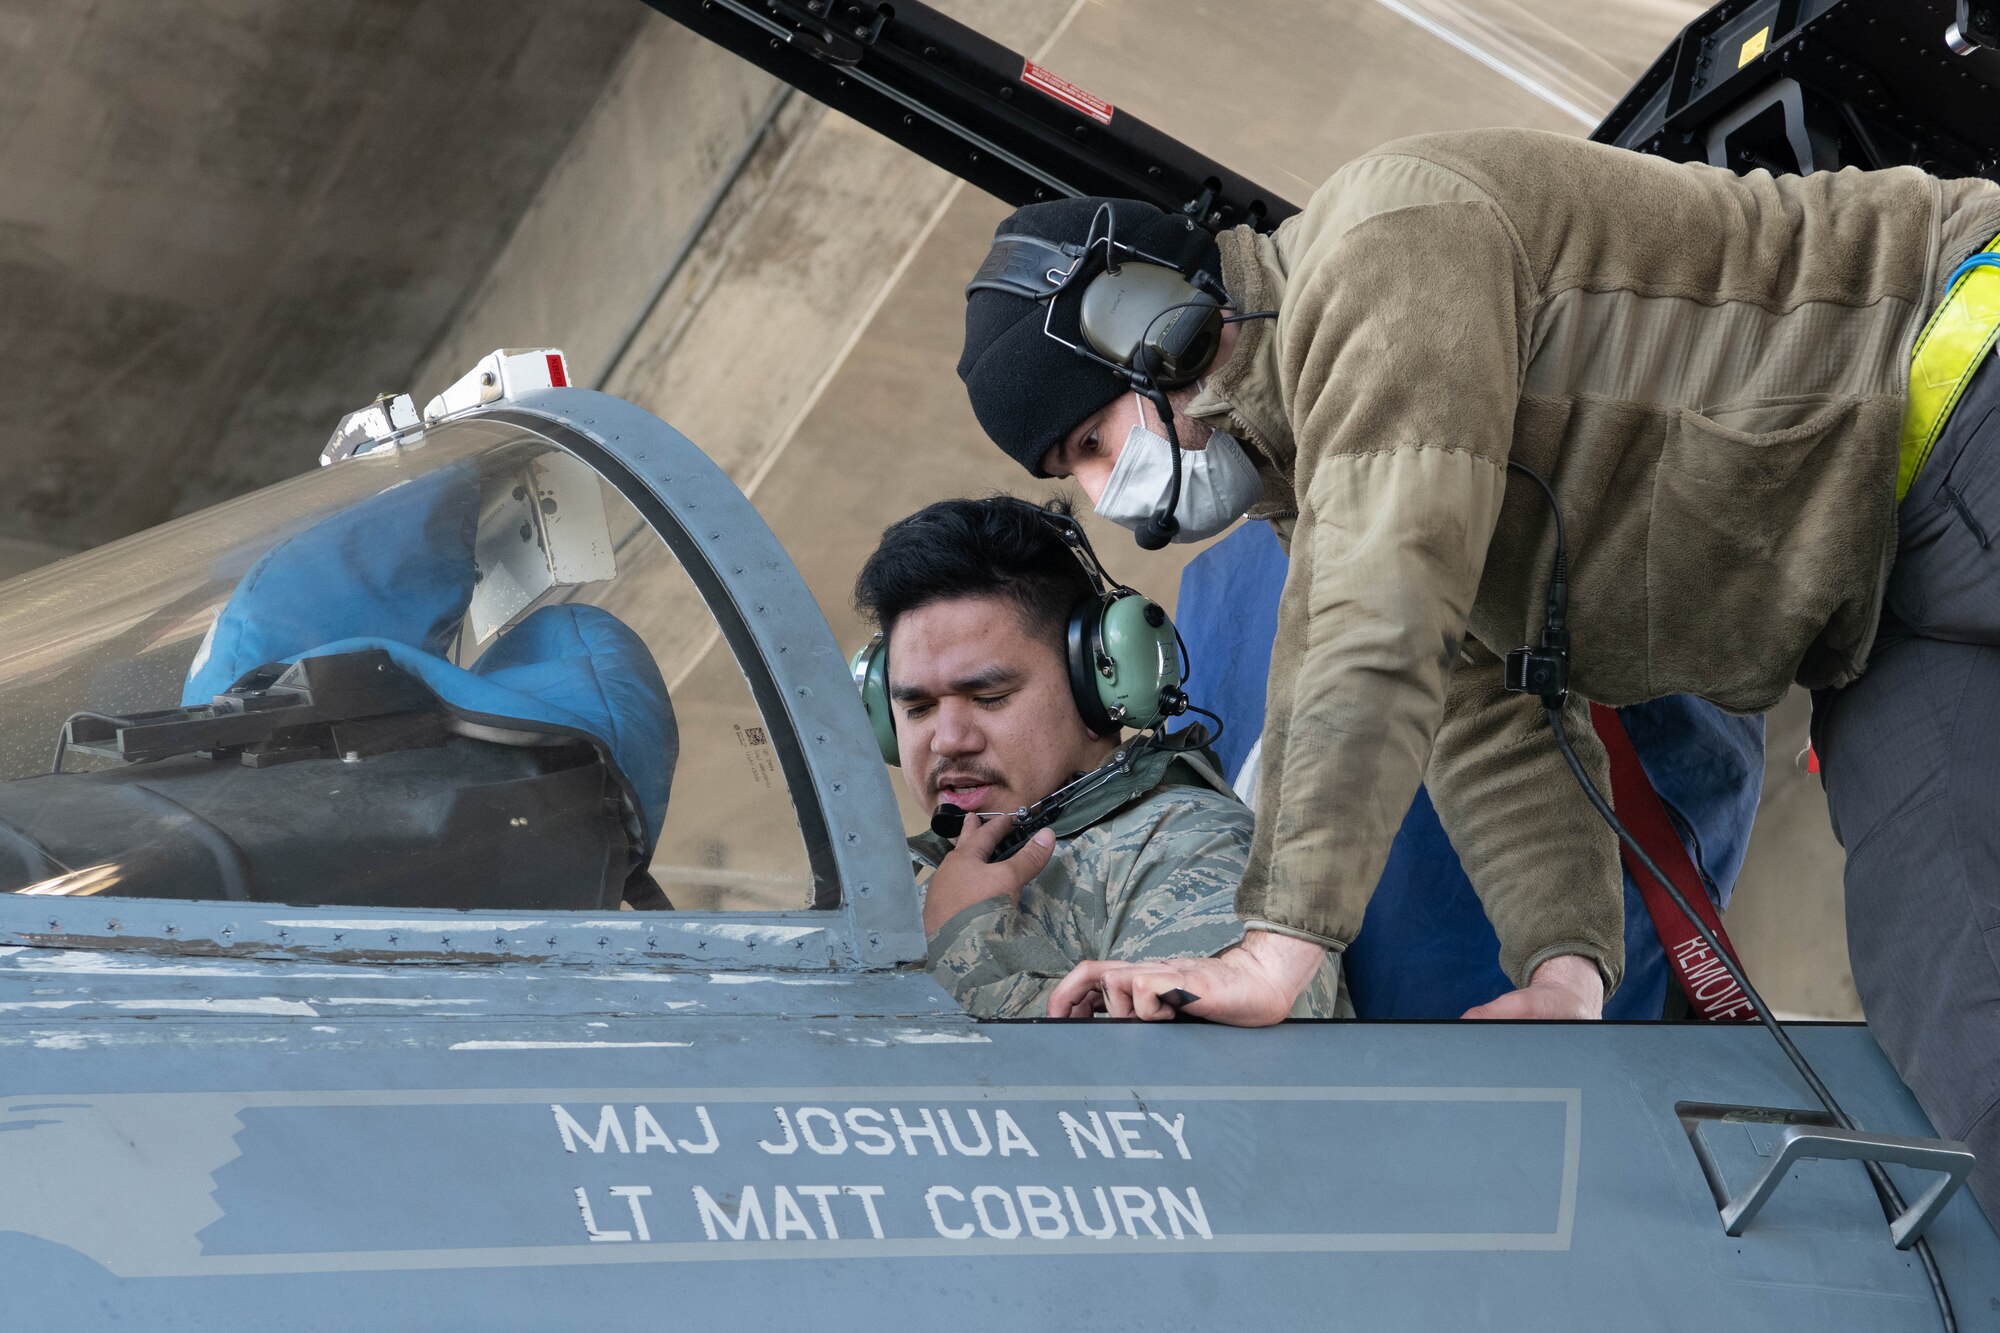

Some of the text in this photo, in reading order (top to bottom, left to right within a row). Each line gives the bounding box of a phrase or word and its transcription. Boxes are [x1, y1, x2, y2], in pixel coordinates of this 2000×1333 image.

[1673, 930, 1754, 1021] REMOVE
[551, 1104, 1193, 1160] MAJ JOSHUA NEY
[574, 1186, 1213, 1241] LT MATT COBURN
